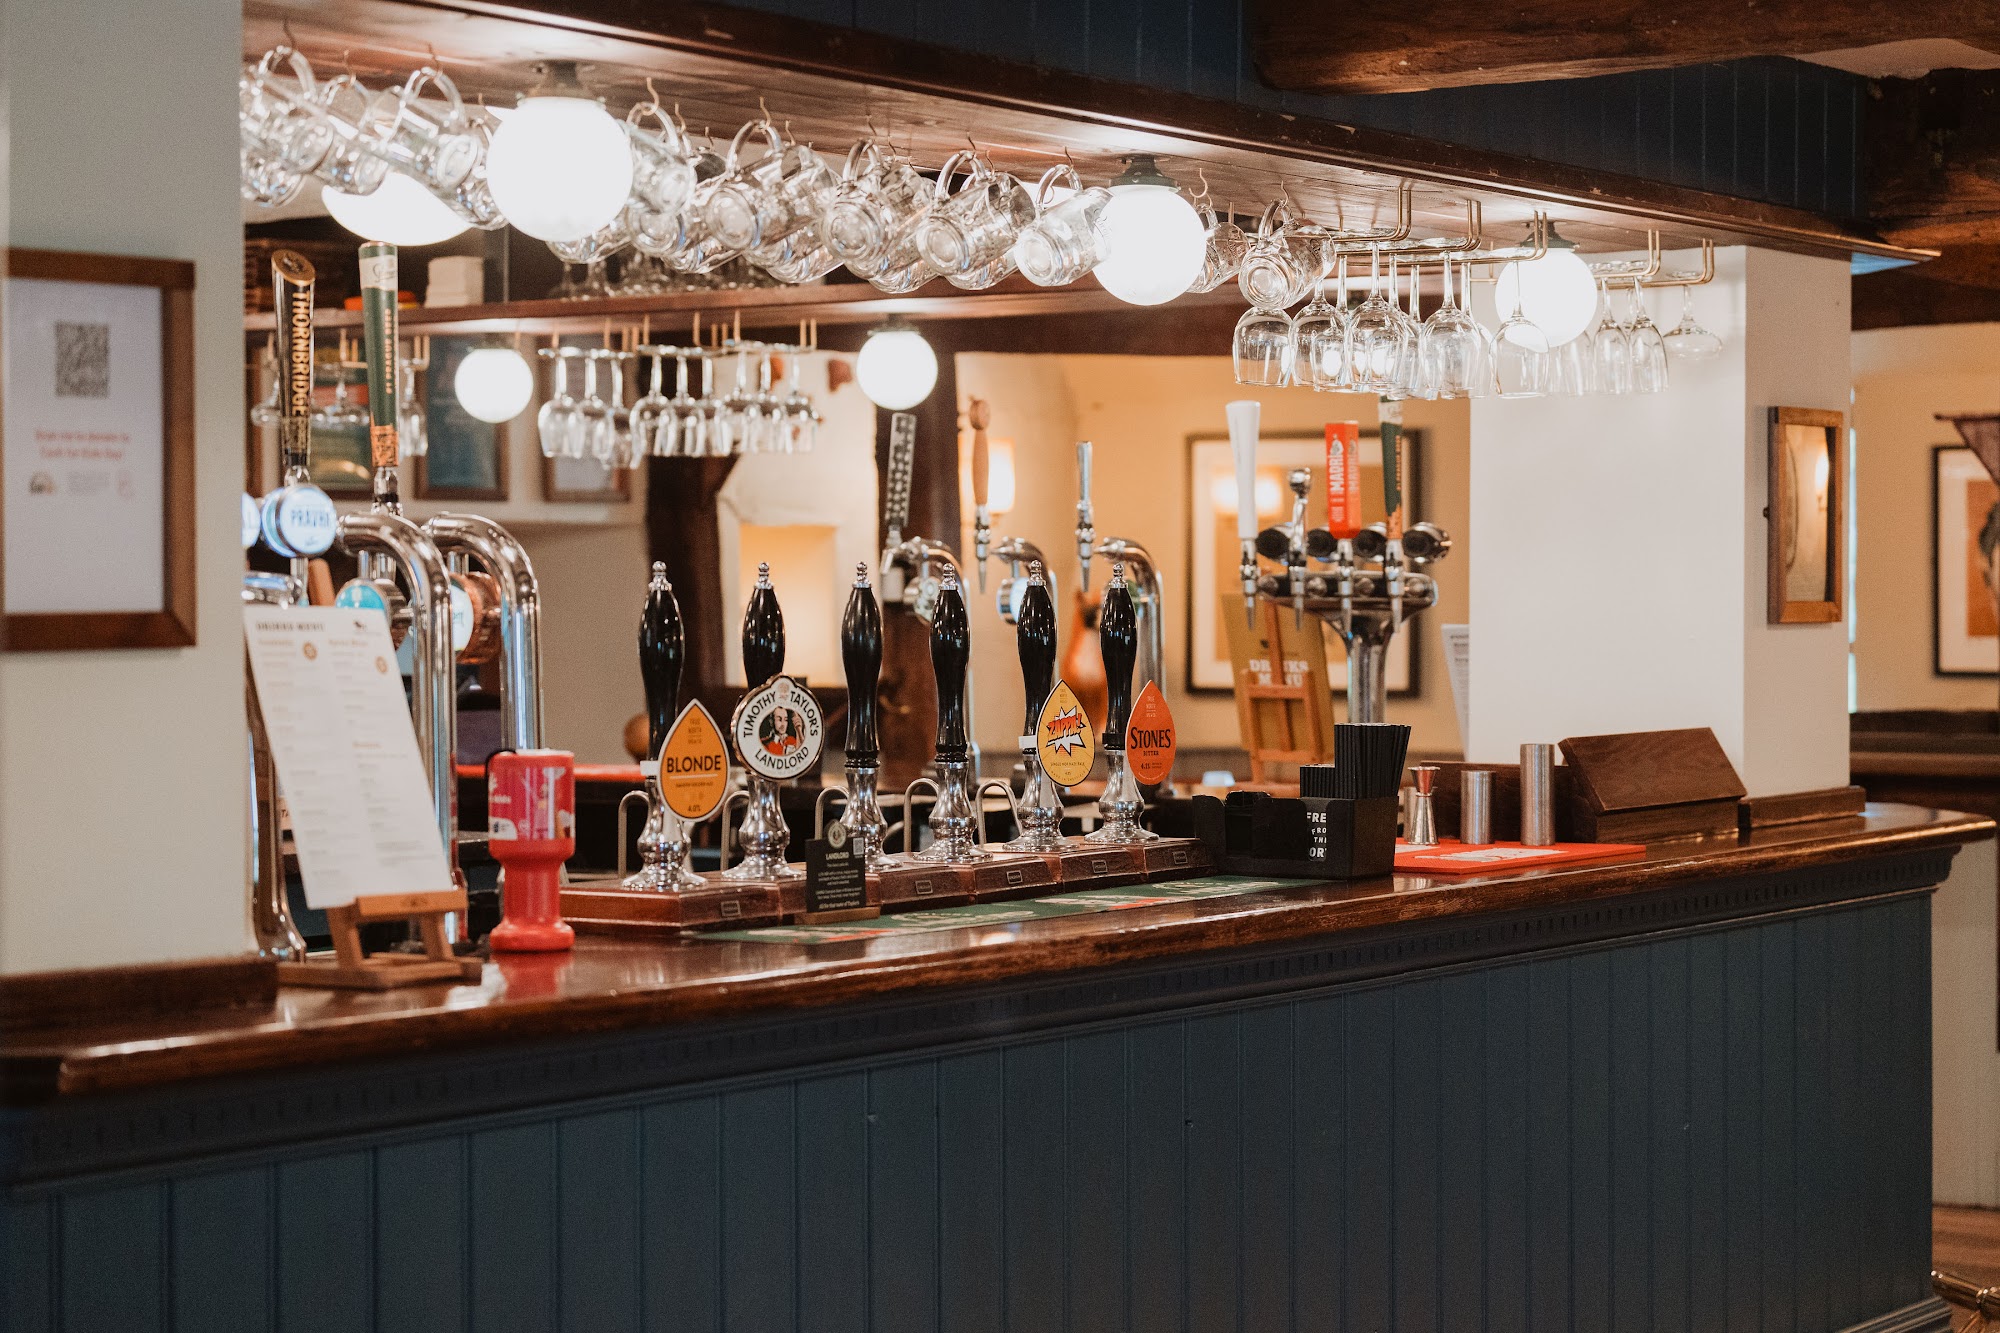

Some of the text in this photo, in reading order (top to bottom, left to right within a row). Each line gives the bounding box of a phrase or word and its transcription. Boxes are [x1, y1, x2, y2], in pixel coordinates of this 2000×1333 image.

[291, 290, 311, 417] THORNBRIDGE
[1249, 659, 1309, 673] DRKS
[743, 690, 820, 738] TIMOTHY TAYLOR'S
[1047, 713, 1083, 737] ZAPPA!
[1130, 726, 1172, 750] STONES
[666, 755, 722, 773] BLONDE
[754, 746, 809, 770] LANDLORD
[1309, 846, 1327, 858] OR
